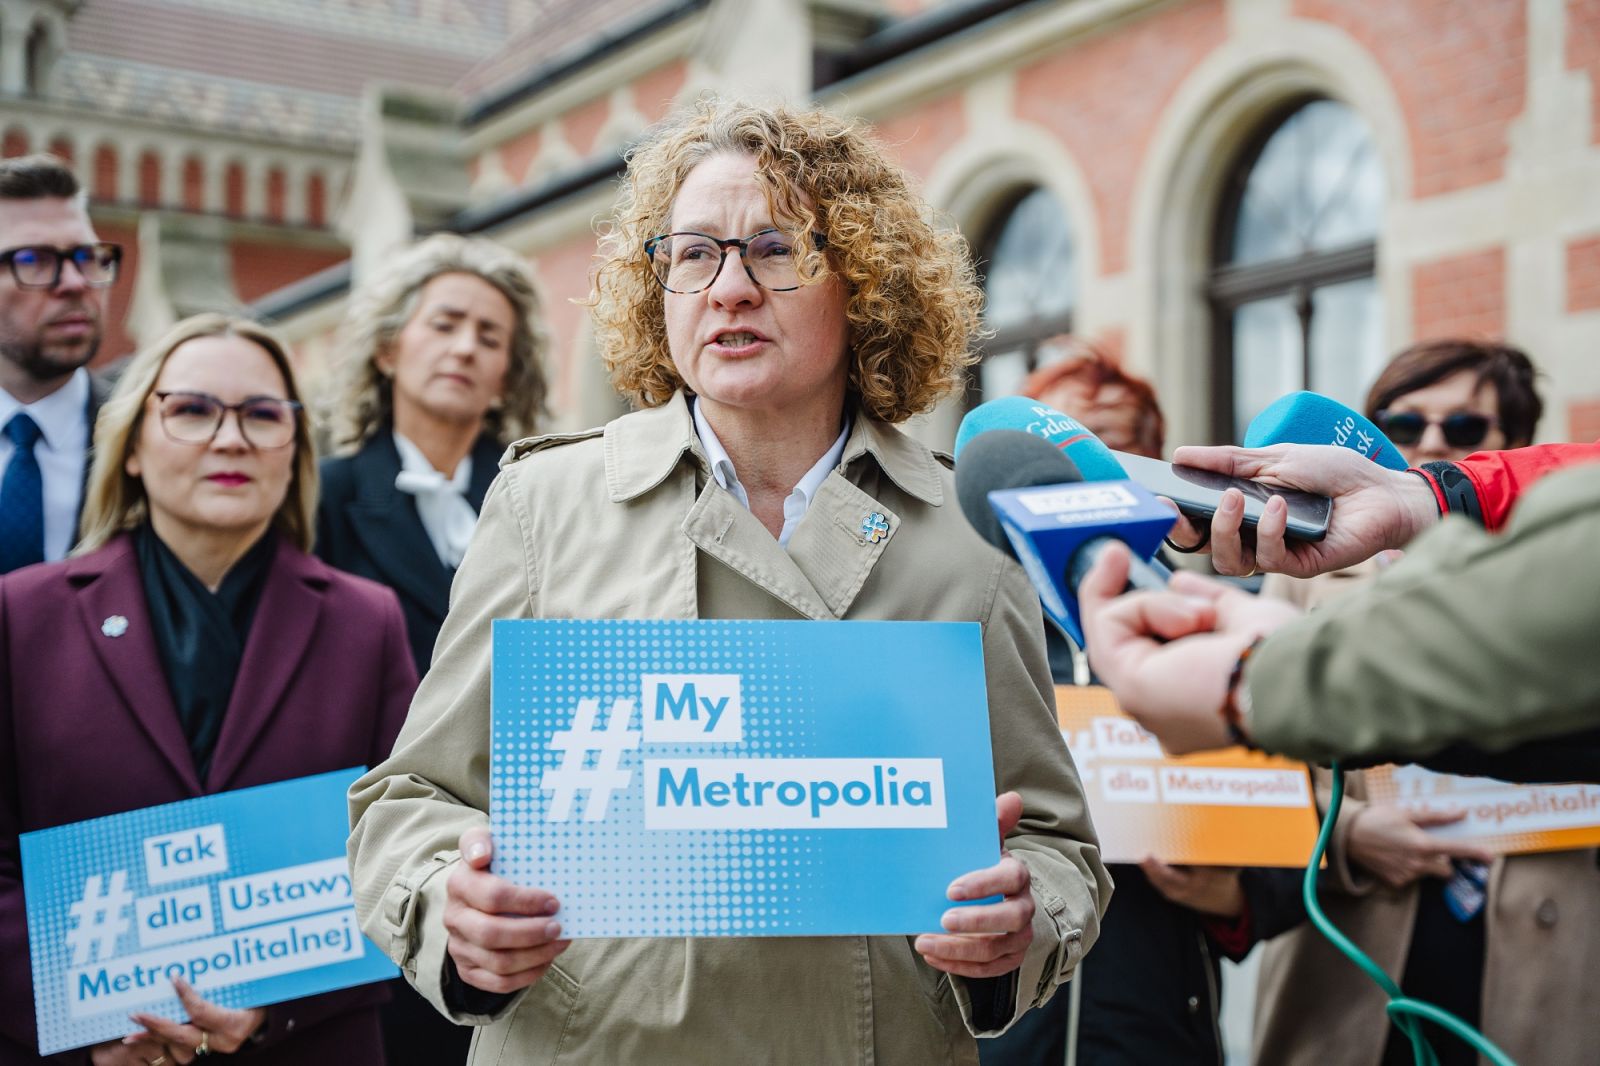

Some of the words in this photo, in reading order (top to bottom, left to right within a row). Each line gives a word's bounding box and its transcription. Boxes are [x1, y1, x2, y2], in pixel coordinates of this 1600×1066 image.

[655, 682, 730, 733] My
[656, 765, 932, 819] Metropolia
[1109, 770, 1148, 790] dla
[153, 835, 216, 868] Tak
[146, 899, 202, 930] dla
[78, 918, 354, 1001] Metropolitalnej
